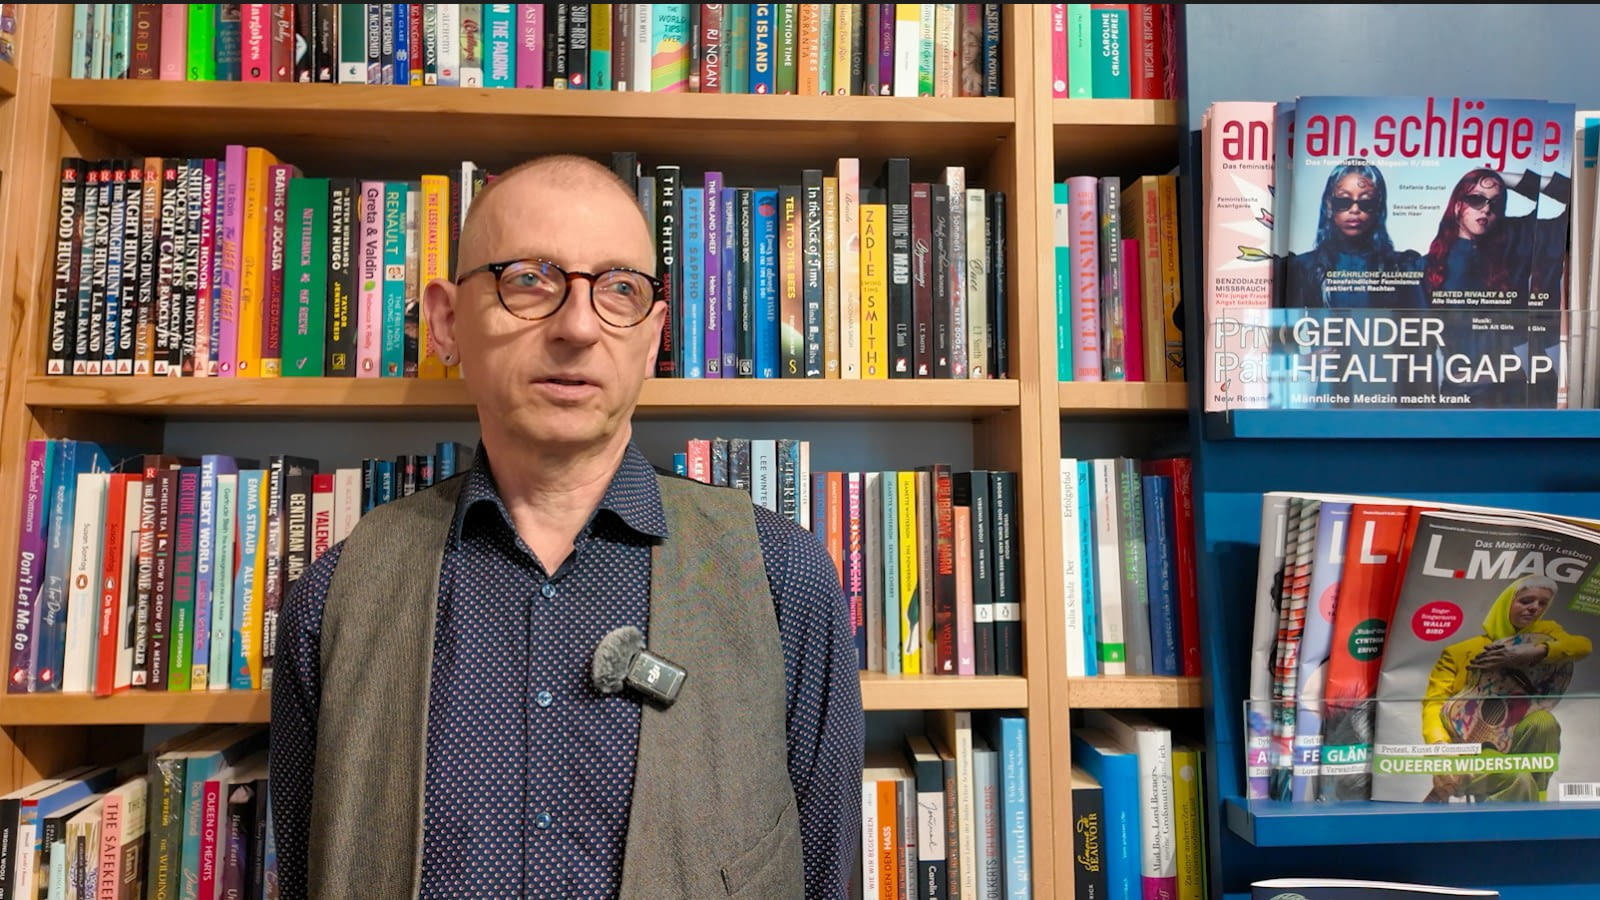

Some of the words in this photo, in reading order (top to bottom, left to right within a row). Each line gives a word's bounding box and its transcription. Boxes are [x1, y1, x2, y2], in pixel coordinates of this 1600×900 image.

[136, 11, 149, 60] LORDE
[493, 21, 509, 39] THE
[524, 28, 535, 51] STOP
[571, 6, 585, 49] SUB-ROSA
[705, 29, 718, 40] RJ
[1102, 13, 1110, 56] CAROLINE
[493, 41, 509, 80] PAIRING
[756, 20, 768, 72] ISLAND
[1112, 13, 1120, 76] CRIADO-PEREZ
[706, 44, 719, 87] NOLAN
[1305, 96, 1534, 172] an.schläge
[1222, 162, 1237, 170] Das
[98, 186, 109, 205] THE
[274, 168, 286, 207] DEATHS
[662, 177, 674, 207] THE
[708, 180, 716, 195] THE
[59, 187, 75, 238] BLOOD
[82, 188, 96, 249] SHADOW
[124, 189, 140, 234] NIGHT
[161, 189, 176, 238] NIGHT
[273, 209, 284, 223] OF
[332, 190, 342, 233] EVELYN
[364, 189, 379, 223] Greta
[689, 197, 698, 240] AFTER
[708, 196, 716, 230] VINLAND
[785, 197, 795, 221] TELL
[95, 207, 109, 245] LONE
[366, 227, 377, 236] &
[385, 192, 399, 256] RENAULT
[662, 215, 674, 265] CHILD
[786, 223, 795, 232] IT
[271, 225, 283, 271] JOCASTA
[331, 236, 341, 270] HUGO
[708, 232, 716, 255] SHEEP
[786, 235, 795, 248] TO
[865, 210, 875, 277] ZADIE
[55, 242, 72, 282] HUNT
[79, 254, 92, 292] HUNT
[92, 248, 106, 286] HUNT
[122, 237, 138, 280] HUNT
[158, 242, 173, 284] CALL
[364, 241, 378, 279] Valdin
[689, 247, 698, 300] SAPPHO
[786, 251, 795, 269] THE
[1326, 270, 1380, 278] GEFÄHRLICHE
[55, 288, 68, 307] L.L.
[122, 286, 134, 307] L.L.
[333, 282, 341, 318] JENKINS
[708, 275, 717, 295] Helen
[787, 273, 796, 299] BEES
[91, 292, 103, 312] L.L.
[707, 297, 717, 330] Shacklady
[51, 309, 65, 351] RAAND
[75, 319, 87, 354] RAAND
[89, 313, 101, 352] RAAND
[119, 309, 133, 350] RAAND
[865, 296, 878, 364] SMITH
[1292, 316, 1447, 348] GENDER
[1291, 353, 1432, 384] HEALTH
[1445, 354, 1521, 384] GAP
[1214, 394, 1234, 403] New
[1290, 393, 1350, 404] Männliche
[1353, 393, 1397, 404] Medizin
[1400, 394, 1436, 404] macht
[1439, 394, 1471, 404] krank
[28, 460, 40, 492] Rachael
[144, 484, 155, 498] THE
[201, 462, 214, 490] THE
[267, 461, 283, 516] Turning
[159, 478, 168, 515] MICHELLE
[200, 494, 212, 525] NEXT
[246, 478, 258, 511] EMMA
[937, 479, 952, 538] DELIBERATE
[1062, 471, 1075, 518] Erfolgspfad
[25, 494, 38, 533] Sommers
[140, 498, 156, 529] LONG
[159, 517, 167, 531] TEA
[288, 493, 306, 552] GENTLEMAN
[140, 531, 155, 555] WAY
[244, 513, 257, 555] STRAUB
[267, 518, 280, 548] The
[848, 481, 862, 593] FRANKISSSTEIN
[198, 528, 211, 573] WORLD
[938, 543, 952, 574] HARM
[1422, 533, 1589, 584] L.MAG
[1475, 539, 1493, 548] Das
[1495, 540, 1535, 550] Magazin
[1538, 542, 1553, 552] für
[1556, 546, 1592, 561] Lesben
[19, 552, 36, 585] Don't
[137, 557, 153, 591] HOME
[157, 559, 165, 577] HOW
[243, 566, 255, 585] ALL
[266, 549, 280, 593] Tables
[17, 587, 32, 606] Let
[104, 595, 113, 606] On
[156, 582, 165, 592] TO
[16, 609, 29, 630] Me
[102, 608, 112, 636] Women
[137, 594, 149, 625] RACHEL
[155, 594, 164, 618] GROW
[241, 587, 254, 628] ADULTS
[14, 633, 27, 651] Go
[154, 621, 163, 633] UP
[134, 626, 147, 665] SPANGLER
[240, 631, 251, 658] HERE
[1380, 758, 1452, 772] QUEERER
[1455, 756, 1554, 772] WIDERSTAND
[1381, 745, 1410, 754] Protest,
[1411, 745, 1432, 754] Kunst
[1434, 745, 1440, 754] &
[1441, 744, 1480, 754] Community
[106, 803, 118, 829] THE
[206, 792, 216, 827] QUEEN
[1160, 779, 1170, 834] Großmutter
[1, 828, 9, 857] VIRGINIA
[206, 830, 215, 842] OF
[883, 826, 892, 850] HASS
[1012, 811, 1028, 881] gefunden
[1088, 812, 1100, 872] BEAUVOIR
[202, 845, 213, 881] HEARTS
[884, 852, 892, 871] DEN
